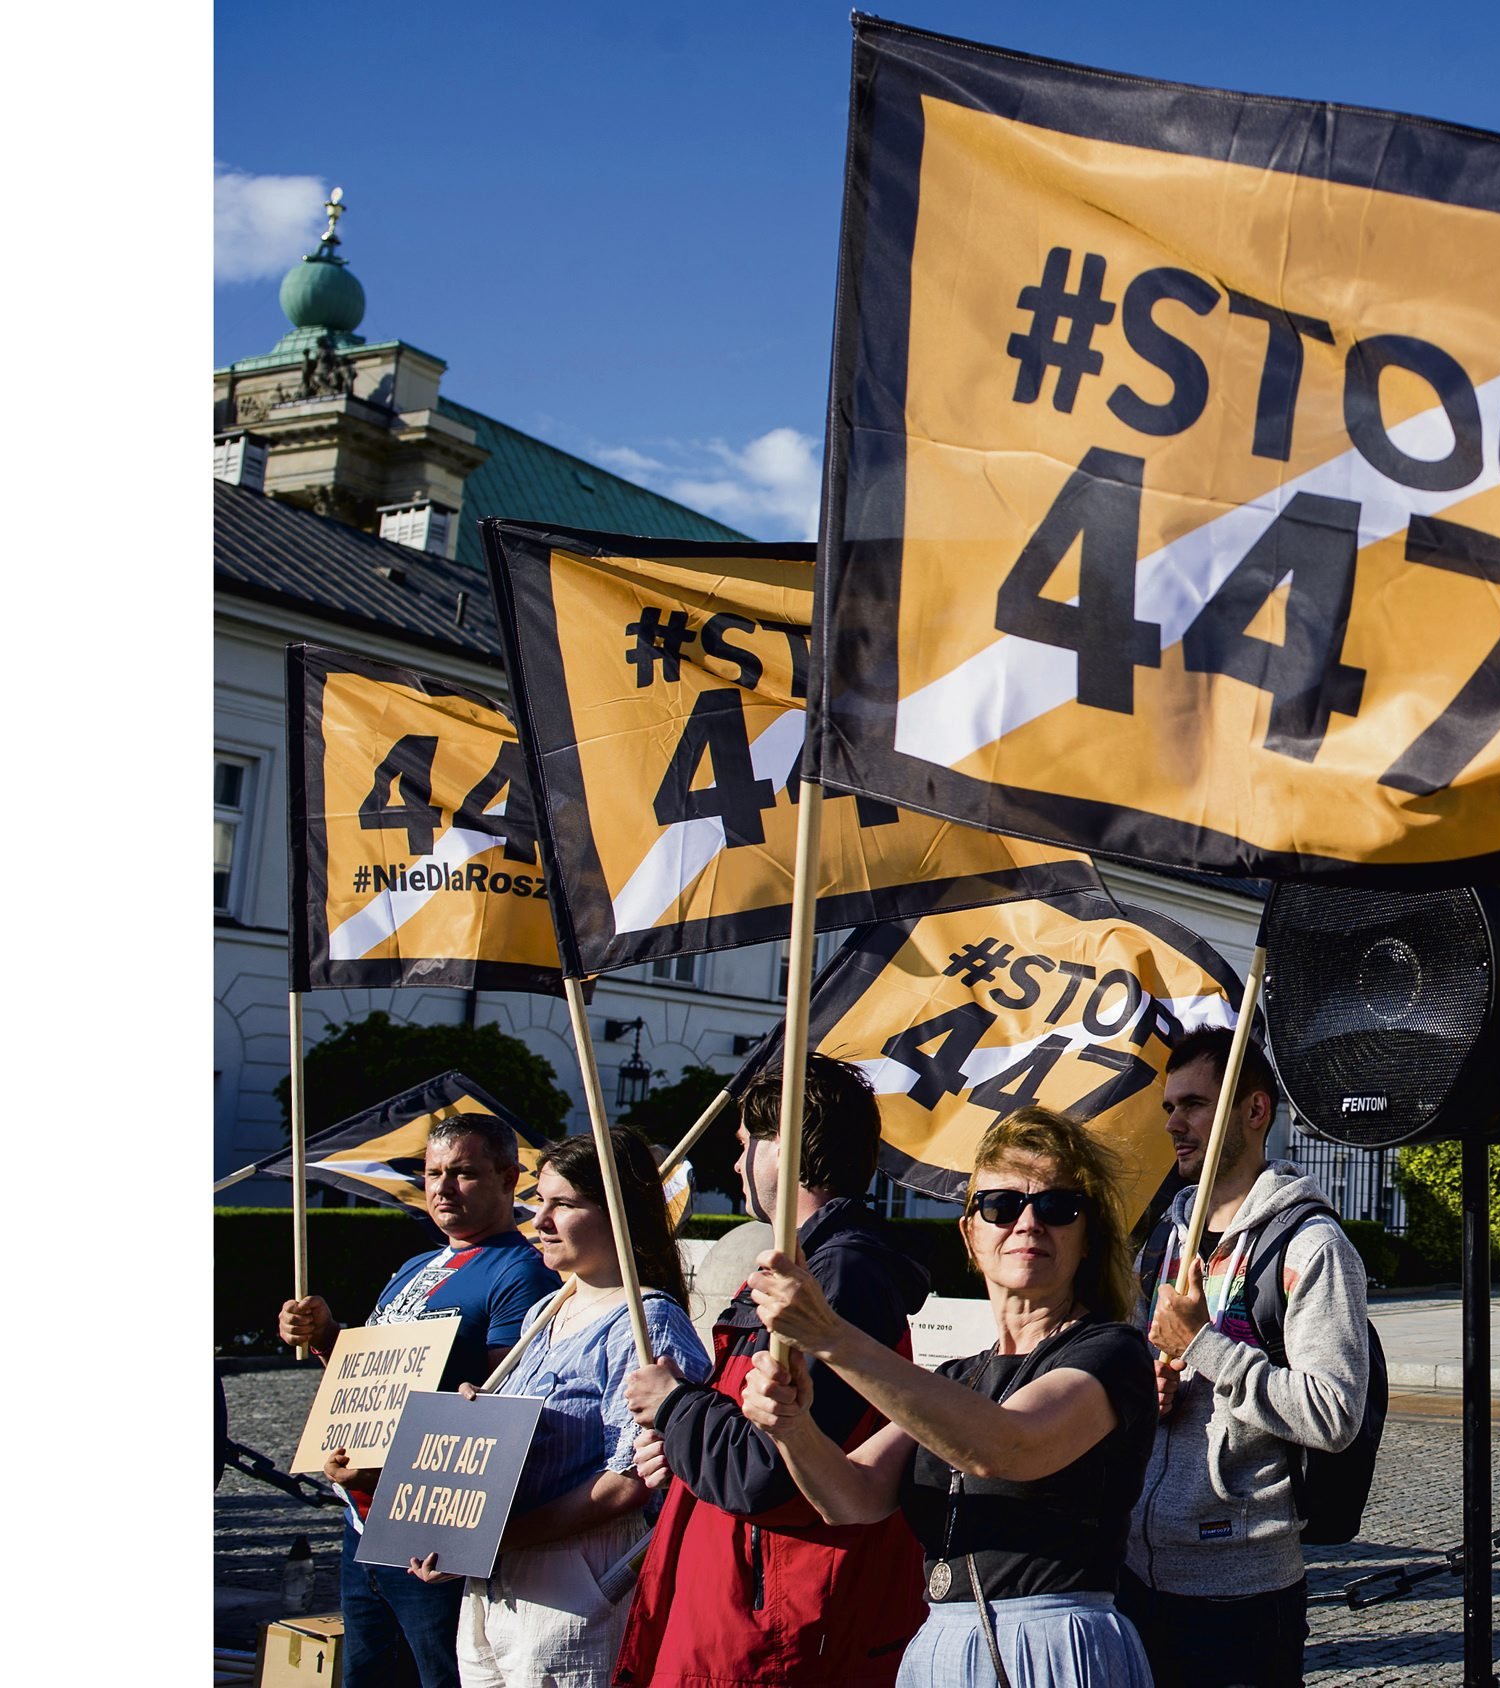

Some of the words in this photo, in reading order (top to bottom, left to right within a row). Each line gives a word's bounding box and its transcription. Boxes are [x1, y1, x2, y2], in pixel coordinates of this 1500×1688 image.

[941, 936, 1184, 1049] #STOP
[881, 1001, 1159, 1131] 447
[1341, 1097, 1384, 1112] FENTON
[337, 1352, 365, 1380] NIE
[361, 1347, 407, 1378] DAMY
[404, 1345, 431, 1378] SIĘ
[330, 1379, 389, 1415] OKRAŚĆ
[384, 1383, 408, 1411] NA
[321, 1422, 352, 1452] 300
[348, 1420, 384, 1450] MLD
[381, 1417, 396, 1449] $
[411, 1433, 461, 1473] JUST
[453, 1436, 498, 1476] ACT
[388, 1482, 413, 1521] IS
[407, 1485, 427, 1523] A
[422, 1486, 487, 1529] FRAUD
